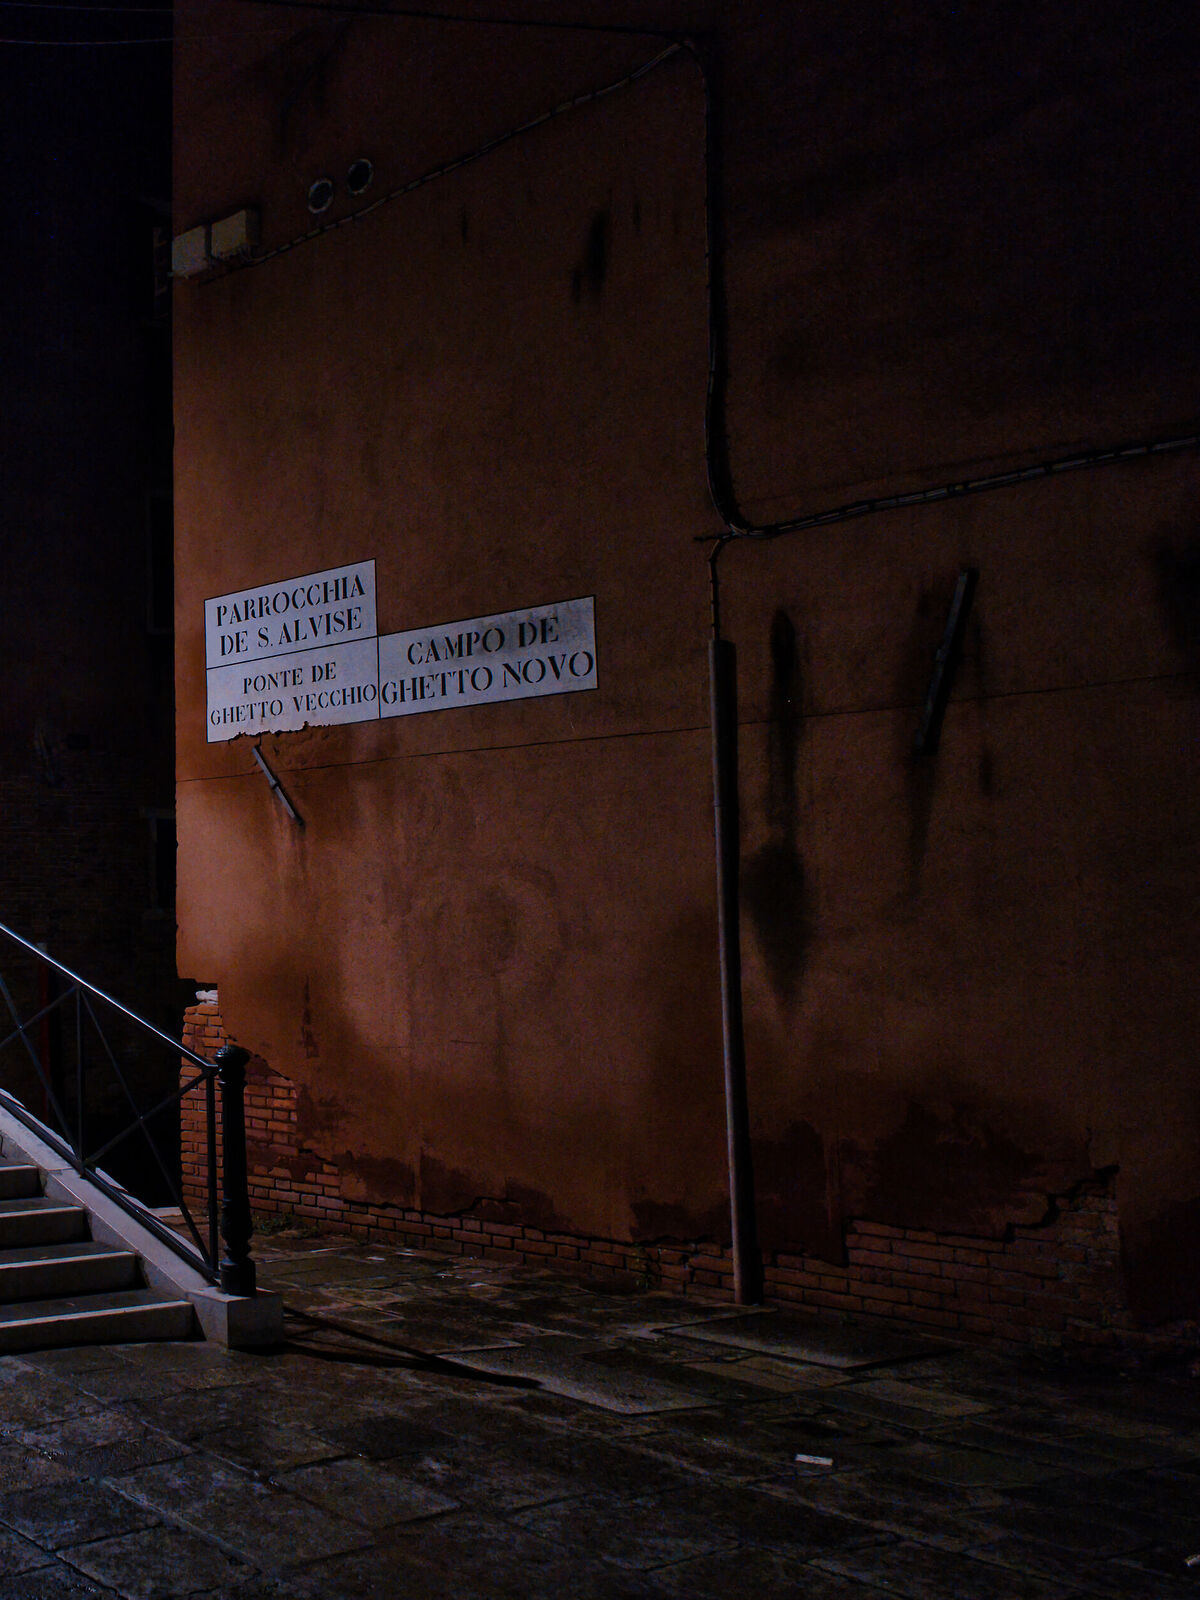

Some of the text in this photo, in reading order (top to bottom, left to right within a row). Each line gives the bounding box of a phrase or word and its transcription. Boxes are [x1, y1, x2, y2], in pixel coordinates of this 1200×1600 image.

[216, 574, 366, 627] PARROCCHIA
[220, 606, 362, 656] DE S. ALVISE
[407, 616, 560, 665] CAMPO DE
[243, 661, 337, 695] PONTE DE
[381, 650, 595, 705] GHETTO NOVO
[210, 683, 378, 726] GHETTO VECCHIO
